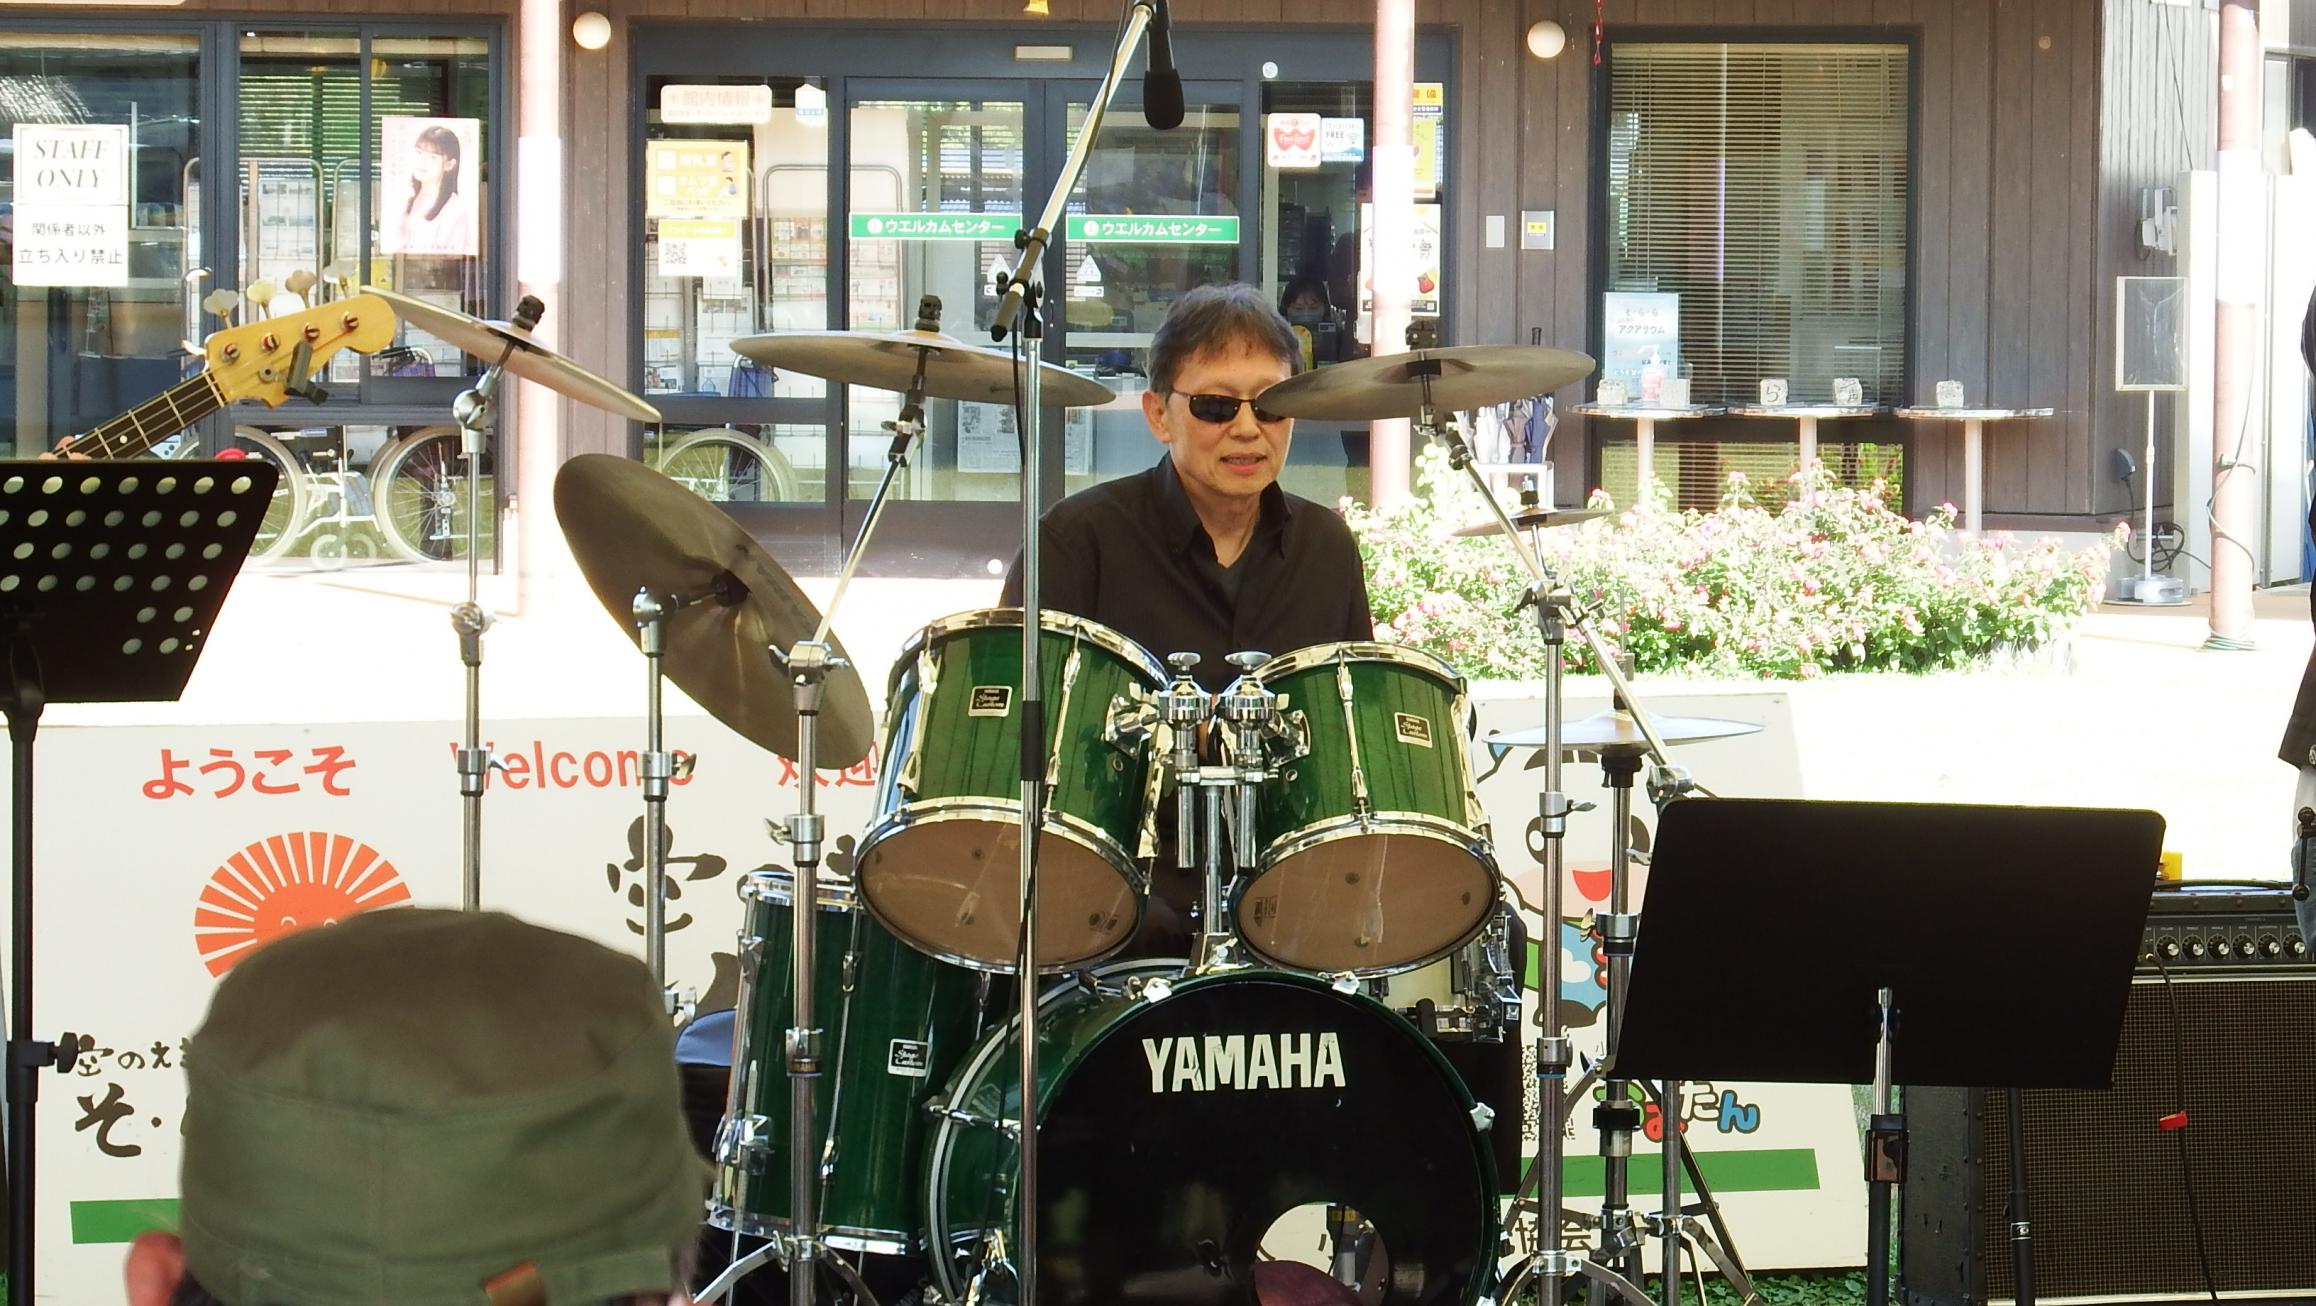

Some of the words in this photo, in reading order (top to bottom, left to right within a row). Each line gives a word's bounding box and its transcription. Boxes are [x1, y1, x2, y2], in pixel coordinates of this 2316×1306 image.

[34, 140, 109, 160] STAFF
[36, 168, 104, 189] ONLY
[32, 222, 105, 237] 関係者以外
[885, 219, 1005, 235] ウエルカムセンター
[1101, 222, 1222, 237] ウエルカムセンター
[18, 248, 123, 265] 立ち入り禁止
[141, 745, 358, 801] ようこそ
[1141, 1030, 1347, 1094] YAMAHA
